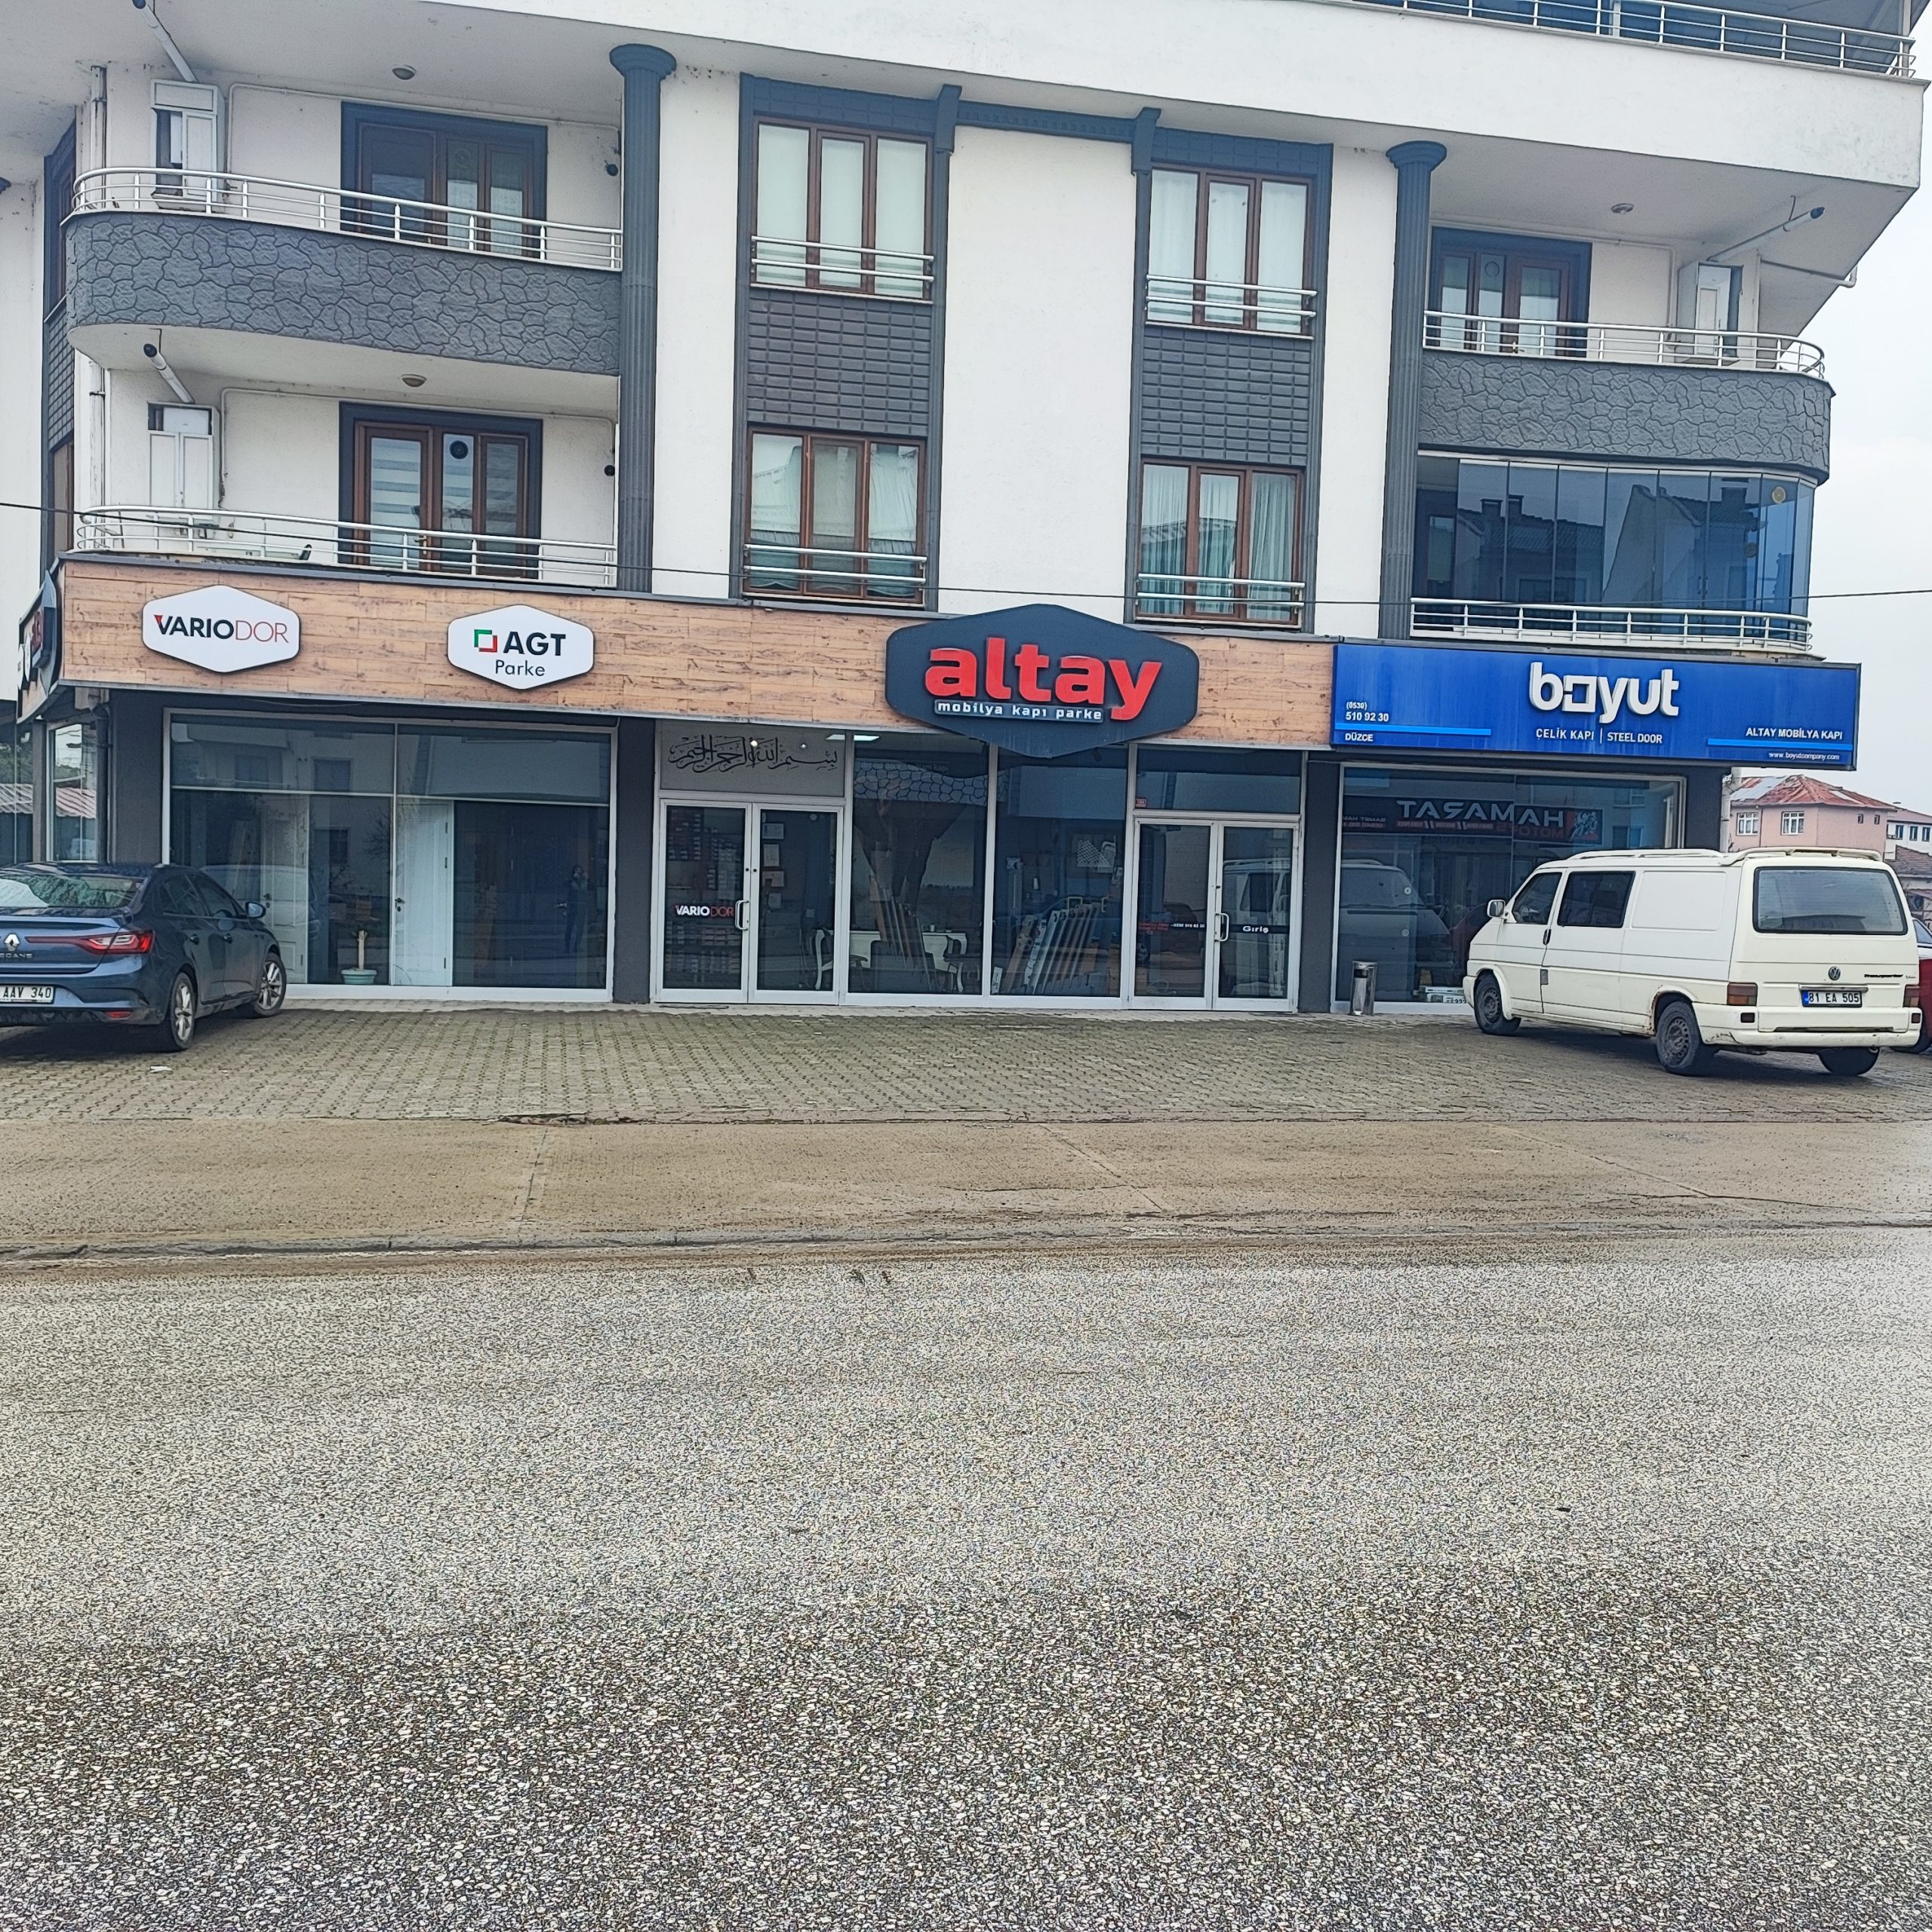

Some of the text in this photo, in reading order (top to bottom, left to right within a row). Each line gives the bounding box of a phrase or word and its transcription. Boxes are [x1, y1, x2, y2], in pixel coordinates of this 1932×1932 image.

[154, 614, 289, 643] VARIODOR
[503, 631, 566, 656] AGT
[495, 659, 546, 677] Parke
[924, 637, 1163, 721] altay
[1529, 661, 1680, 724] boyut
[937, 701, 1103, 721] mobilya kapı parke
[1346, 701, 1367, 710] (0530)
[1345, 711, 1389, 722] 510 92 30
[1345, 731, 1374, 742] DÜZCE
[1536, 727, 1663, 744] ÇELİK KAPI STEEL DOOR
[1746, 727, 1843, 740] ALTAY MOBİLYA KAPI
[675, 905, 734, 917] VARIODOR
[3, 986, 51, 998] AAV 340
[1808, 992, 1860, 1003] 81 EA 505
